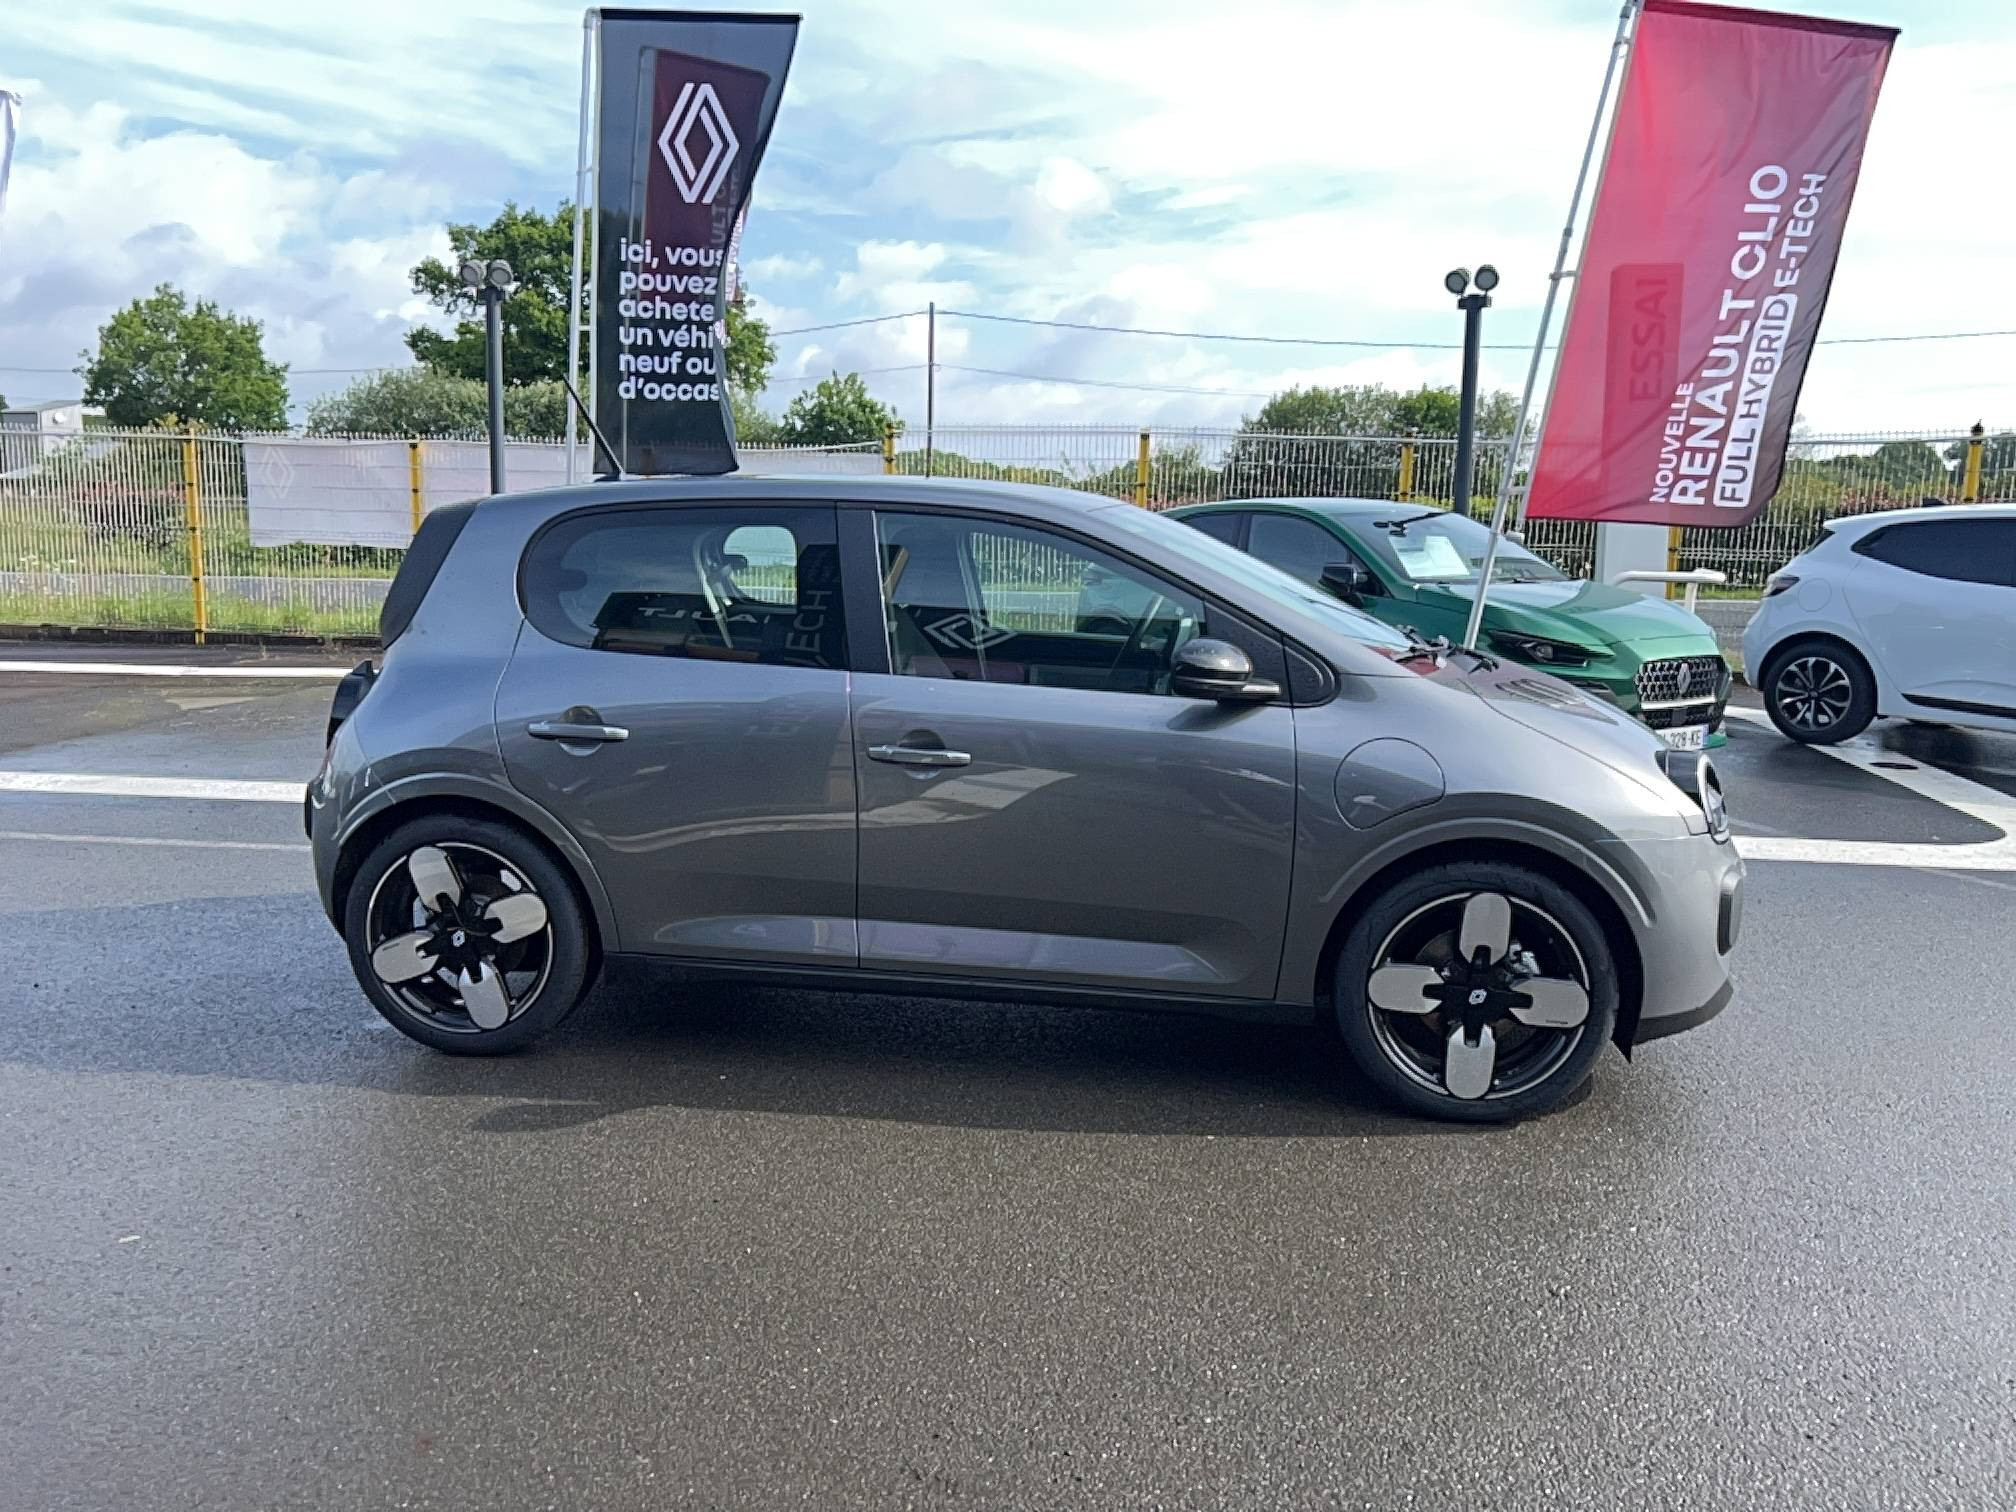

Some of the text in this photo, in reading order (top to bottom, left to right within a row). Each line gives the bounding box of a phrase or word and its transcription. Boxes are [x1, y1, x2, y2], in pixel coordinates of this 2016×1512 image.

[620, 237, 659, 269] ici,
[619, 270, 717, 295] pouvez
[618, 295, 714, 321] achete
[618, 324, 714, 349] un véhi
[1629, 279, 1667, 402] ESSAI
[1670, 164, 1788, 506] RENAULT CLIO
[1719, 173, 1827, 502] FULL HYBRID E-TECH
[618, 351, 717, 375] neuf ou
[1649, 382, 1694, 503] NOUVELLE
